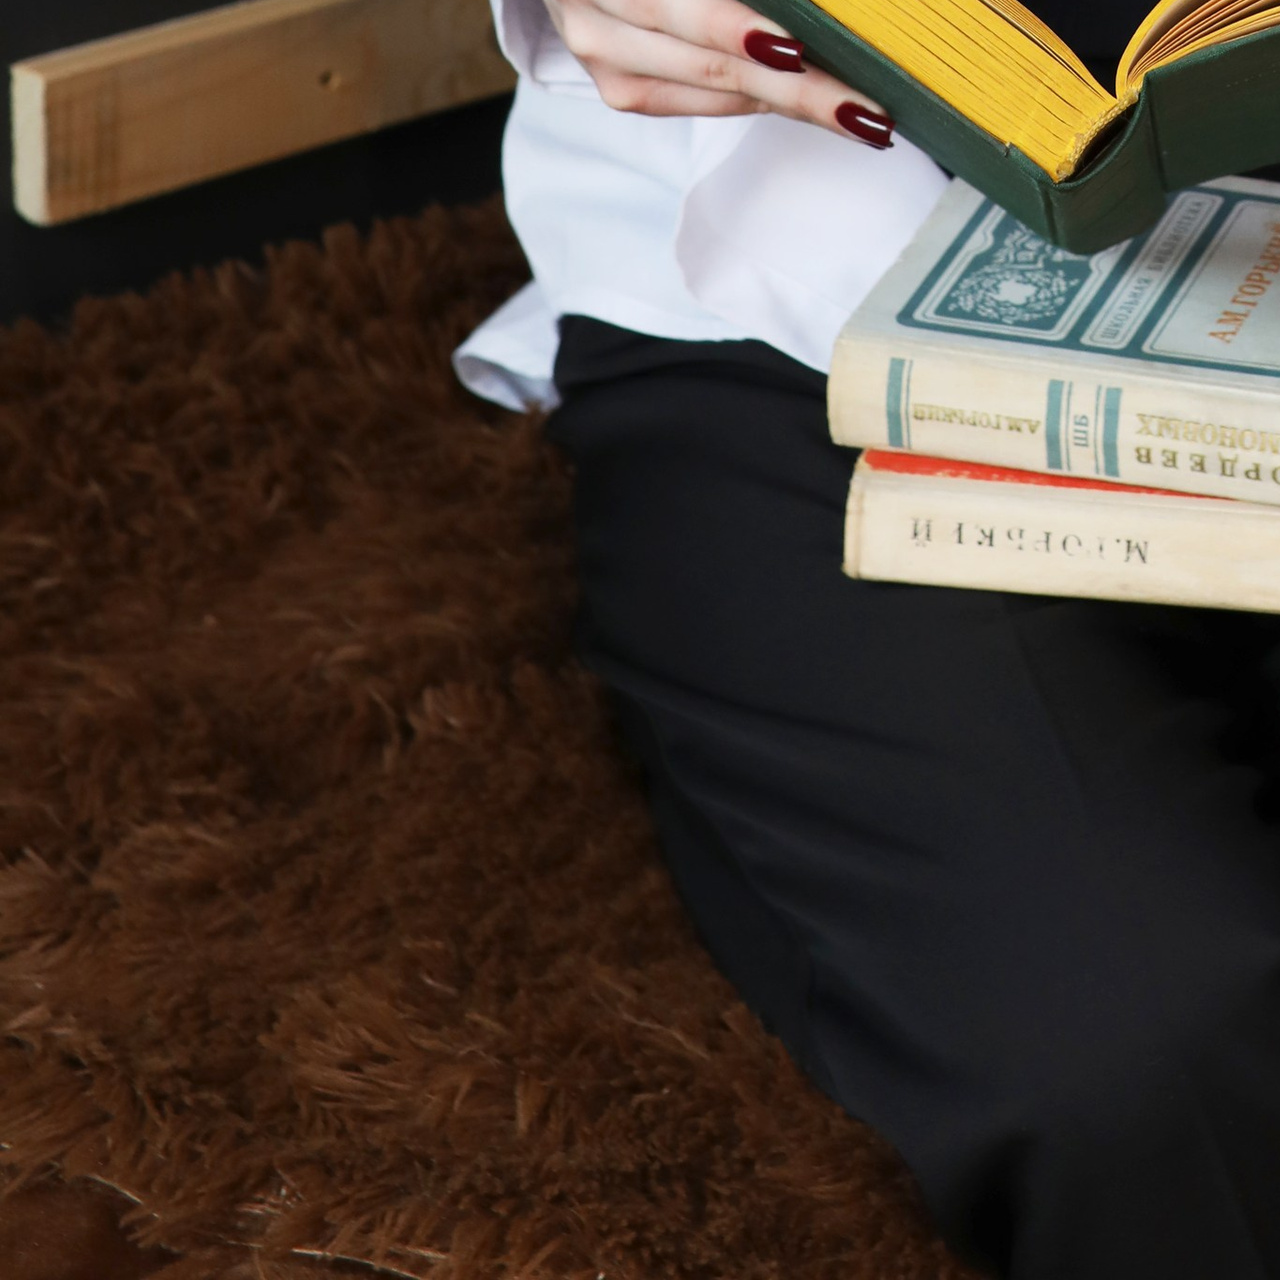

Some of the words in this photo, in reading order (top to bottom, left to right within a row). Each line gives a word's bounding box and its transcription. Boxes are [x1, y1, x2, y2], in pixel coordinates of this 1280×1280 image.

[1101, 277, 1153, 340] ШКОЛЬНАЯ
[1147, 200, 1204, 272] БИБЛИОТЕКА
[1073, 414, 1090, 448] ШБ
